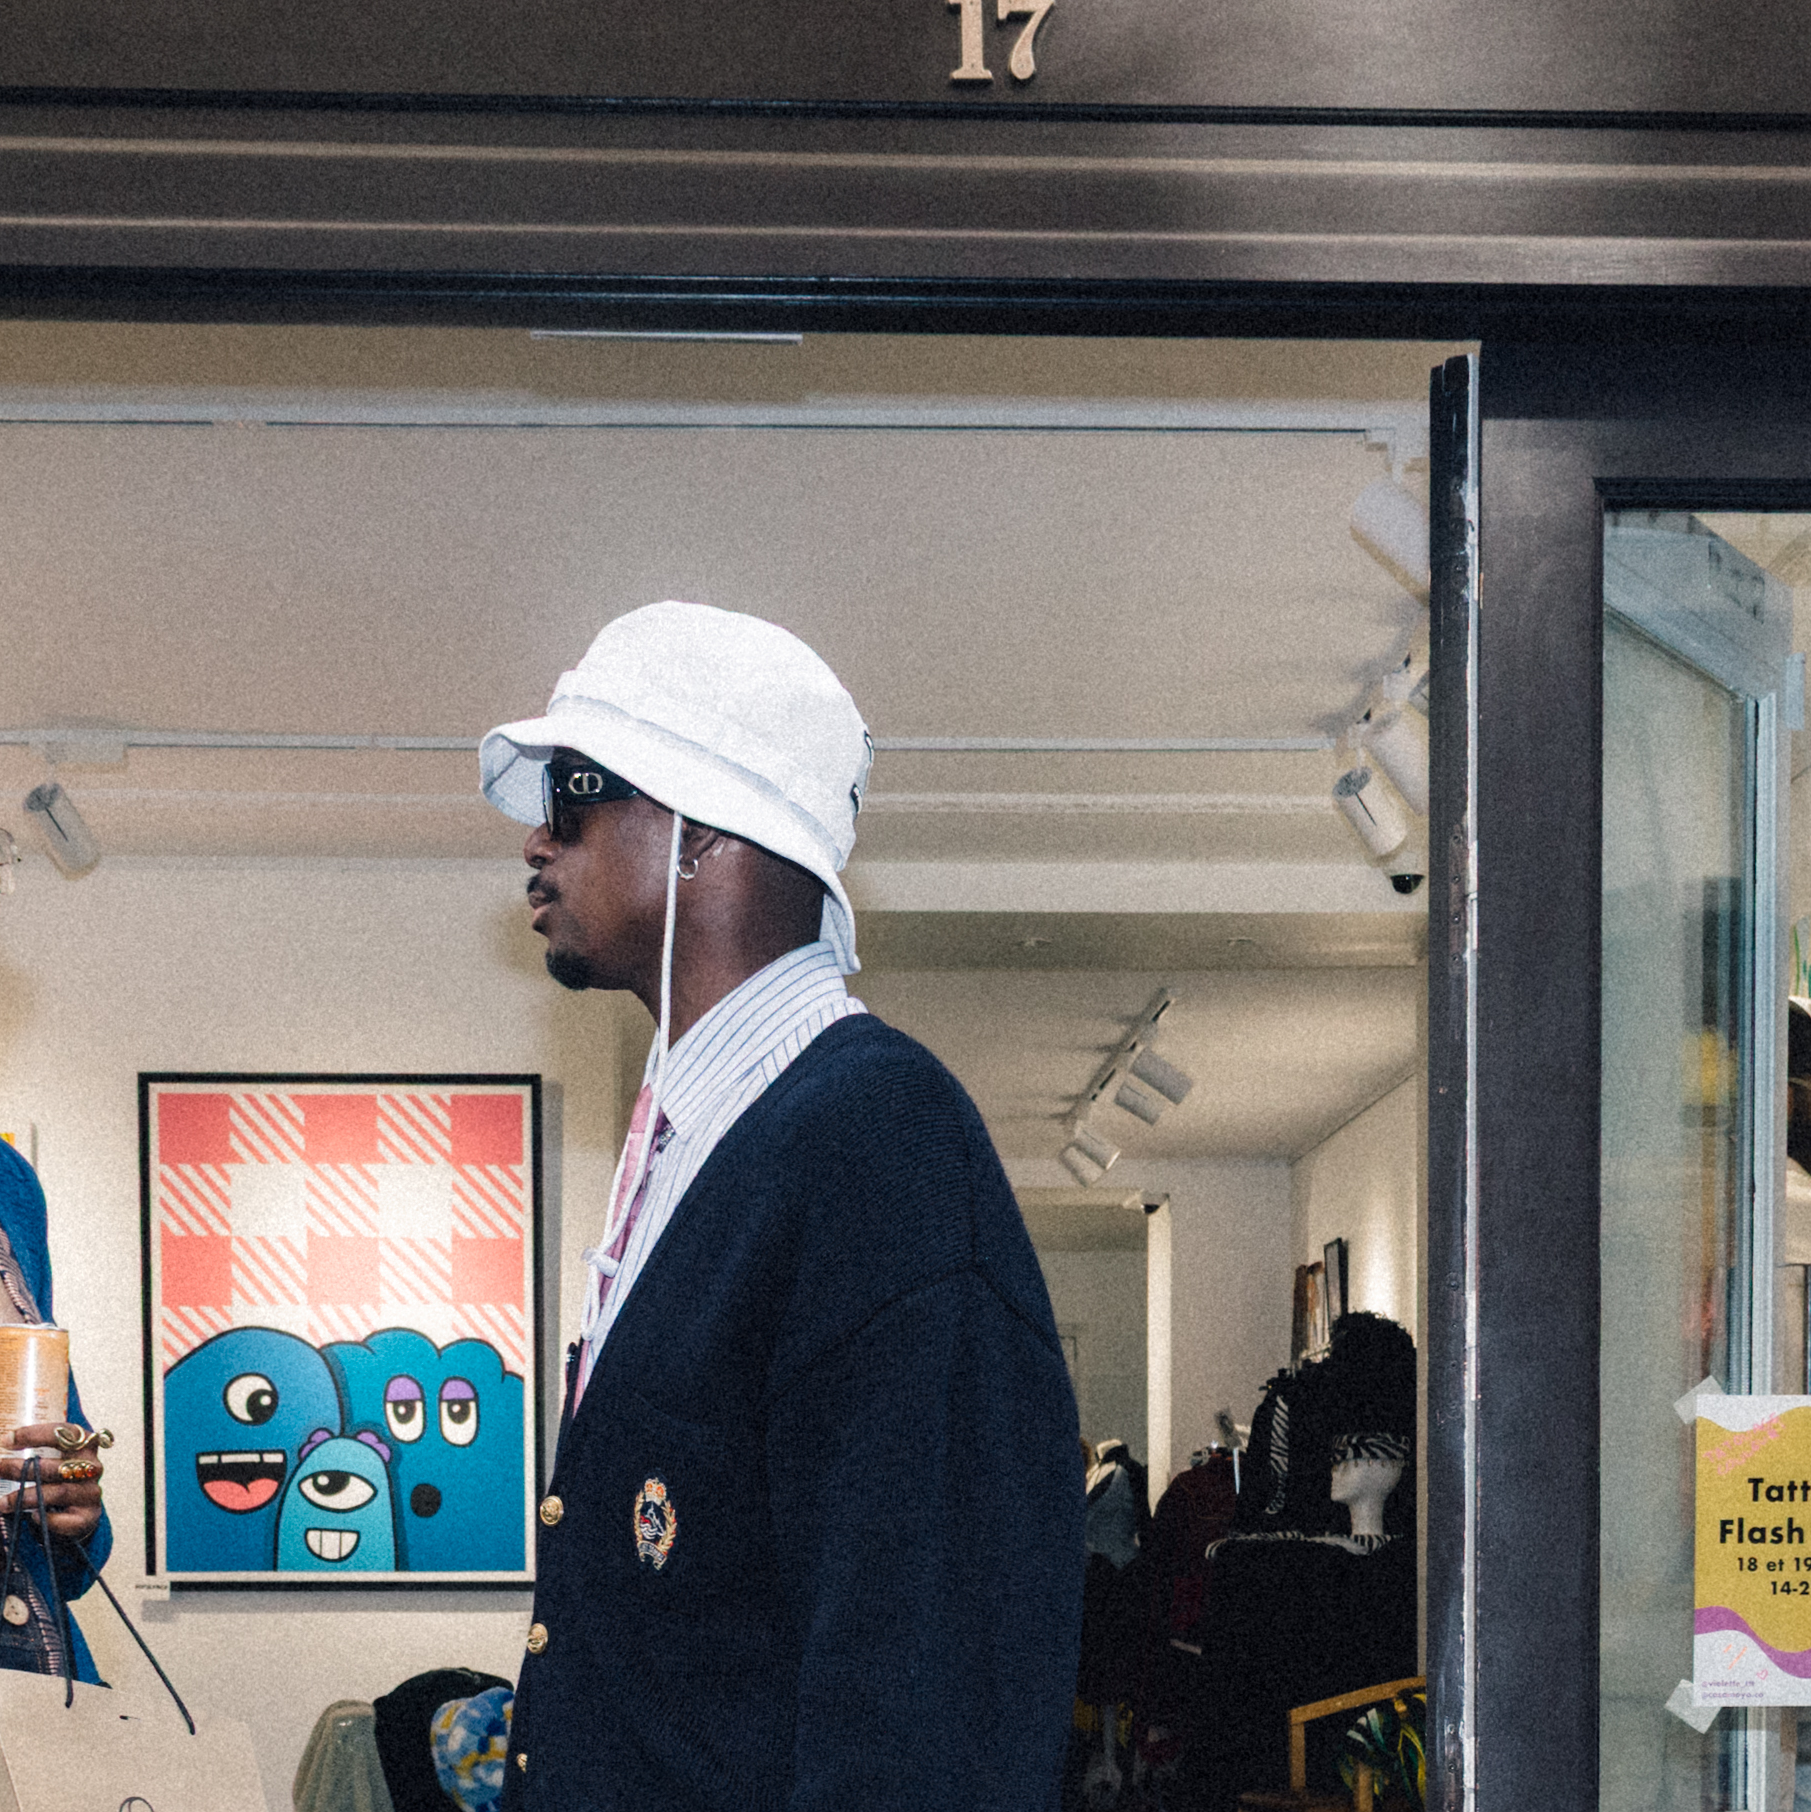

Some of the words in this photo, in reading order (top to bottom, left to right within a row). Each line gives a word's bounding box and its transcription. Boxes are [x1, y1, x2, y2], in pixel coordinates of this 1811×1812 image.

[948, 0, 1055, 80] 17
[1719, 1517, 1805, 1545] Flash
[1738, 1557, 1758, 1572] 18
[1766, 1559, 1784, 1572] et
